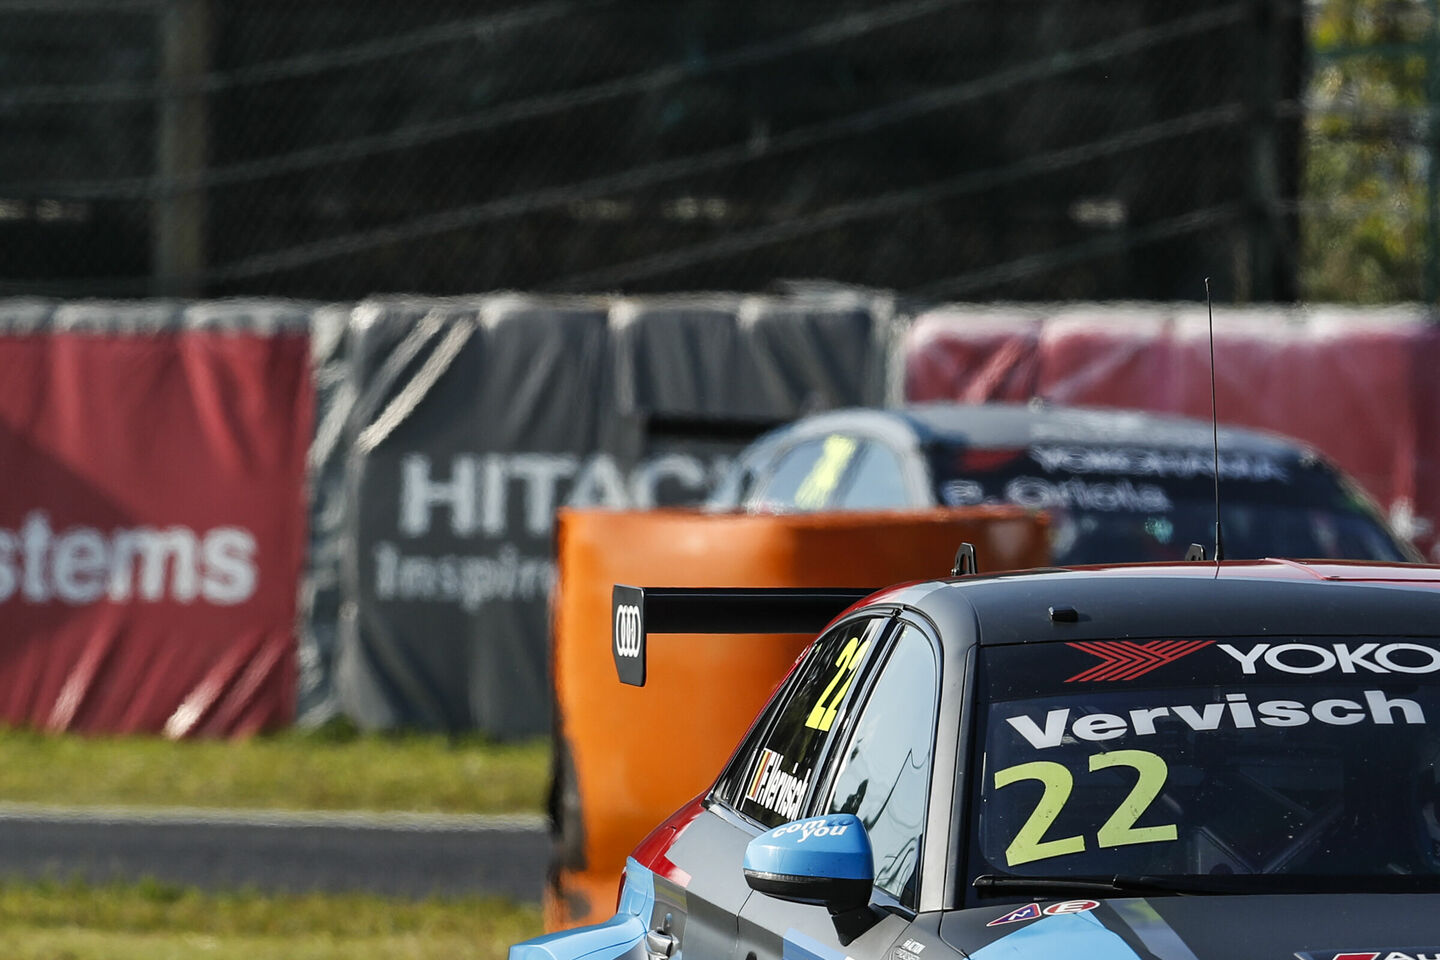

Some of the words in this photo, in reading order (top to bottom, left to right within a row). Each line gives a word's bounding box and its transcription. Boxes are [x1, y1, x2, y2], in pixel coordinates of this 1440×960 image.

[0, 508, 258, 606] tems
[805, 637, 871, 732] 22
[1006, 690, 1426, 749] Vervisch
[772, 819, 827, 838] com
[797, 825, 848, 843] you
[994, 749, 1178, 867] 22
